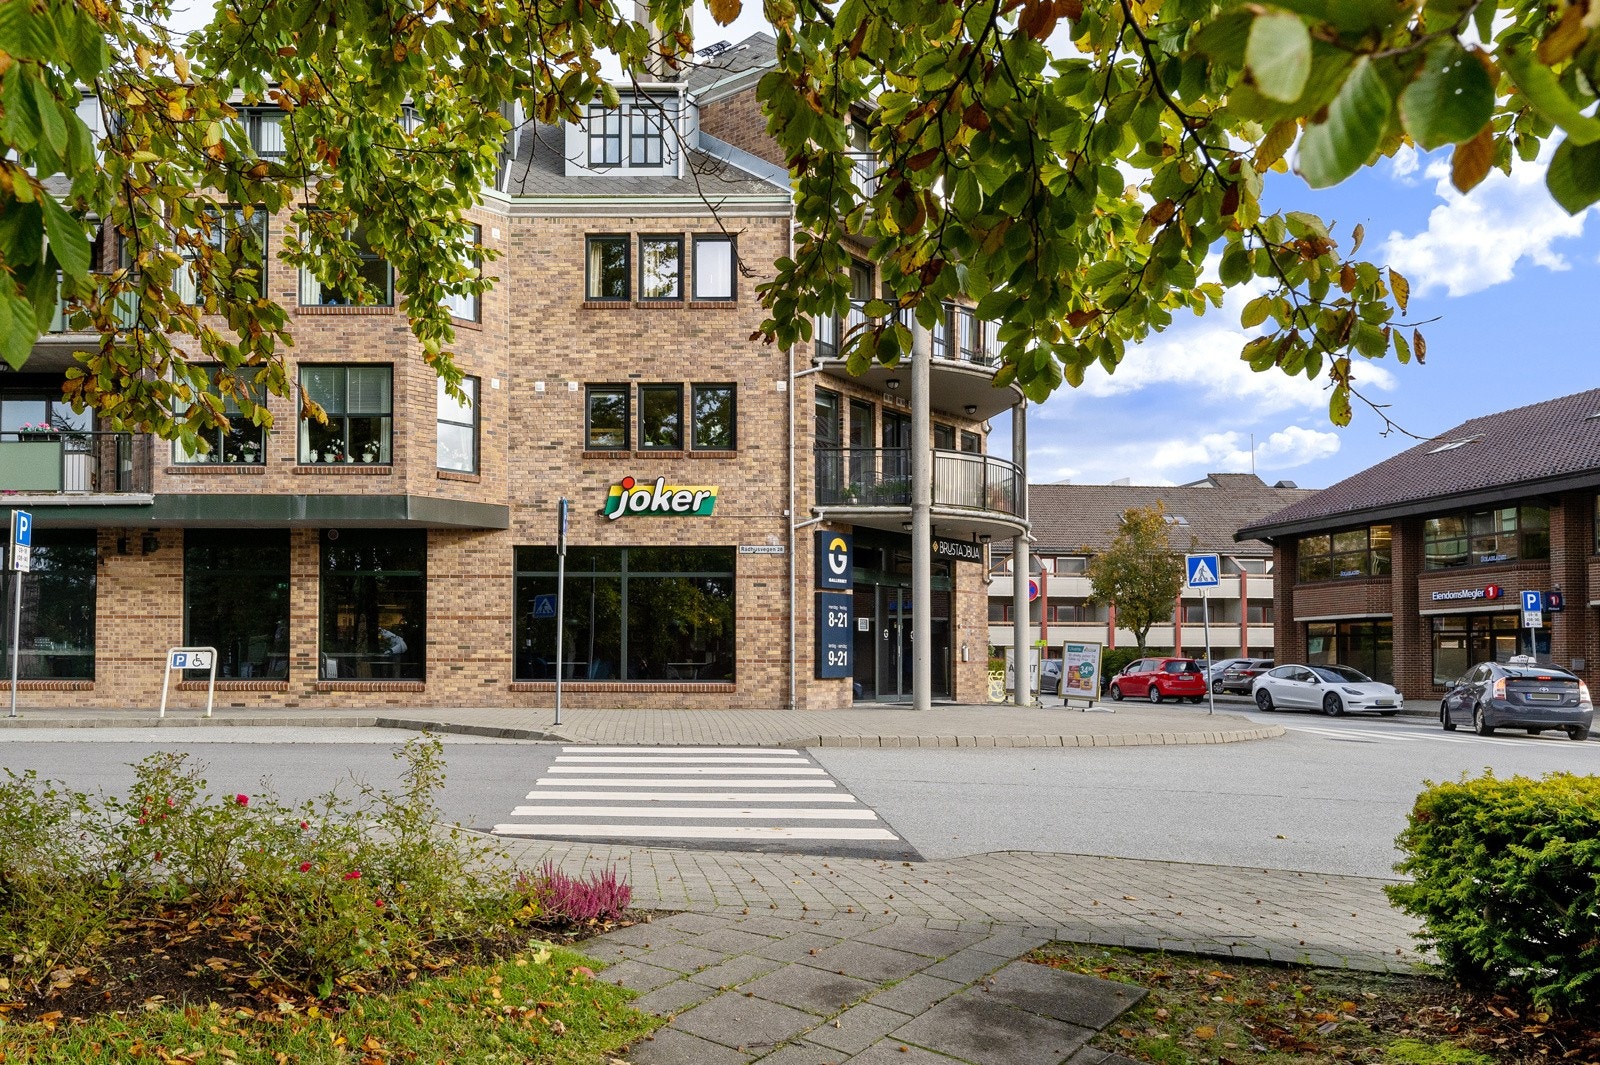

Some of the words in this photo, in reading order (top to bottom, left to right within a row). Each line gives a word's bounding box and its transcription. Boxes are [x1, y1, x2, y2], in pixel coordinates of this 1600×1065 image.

[608, 476, 711, 520] joker
[20, 516, 28, 540] P
[1432, 589, 1484, 600] EiendomsMegler
[1527, 593, 1536, 609] P
[828, 611, 847, 628] 8-21
[176, 655, 185, 666] P
[828, 650, 847, 666] 9-21
